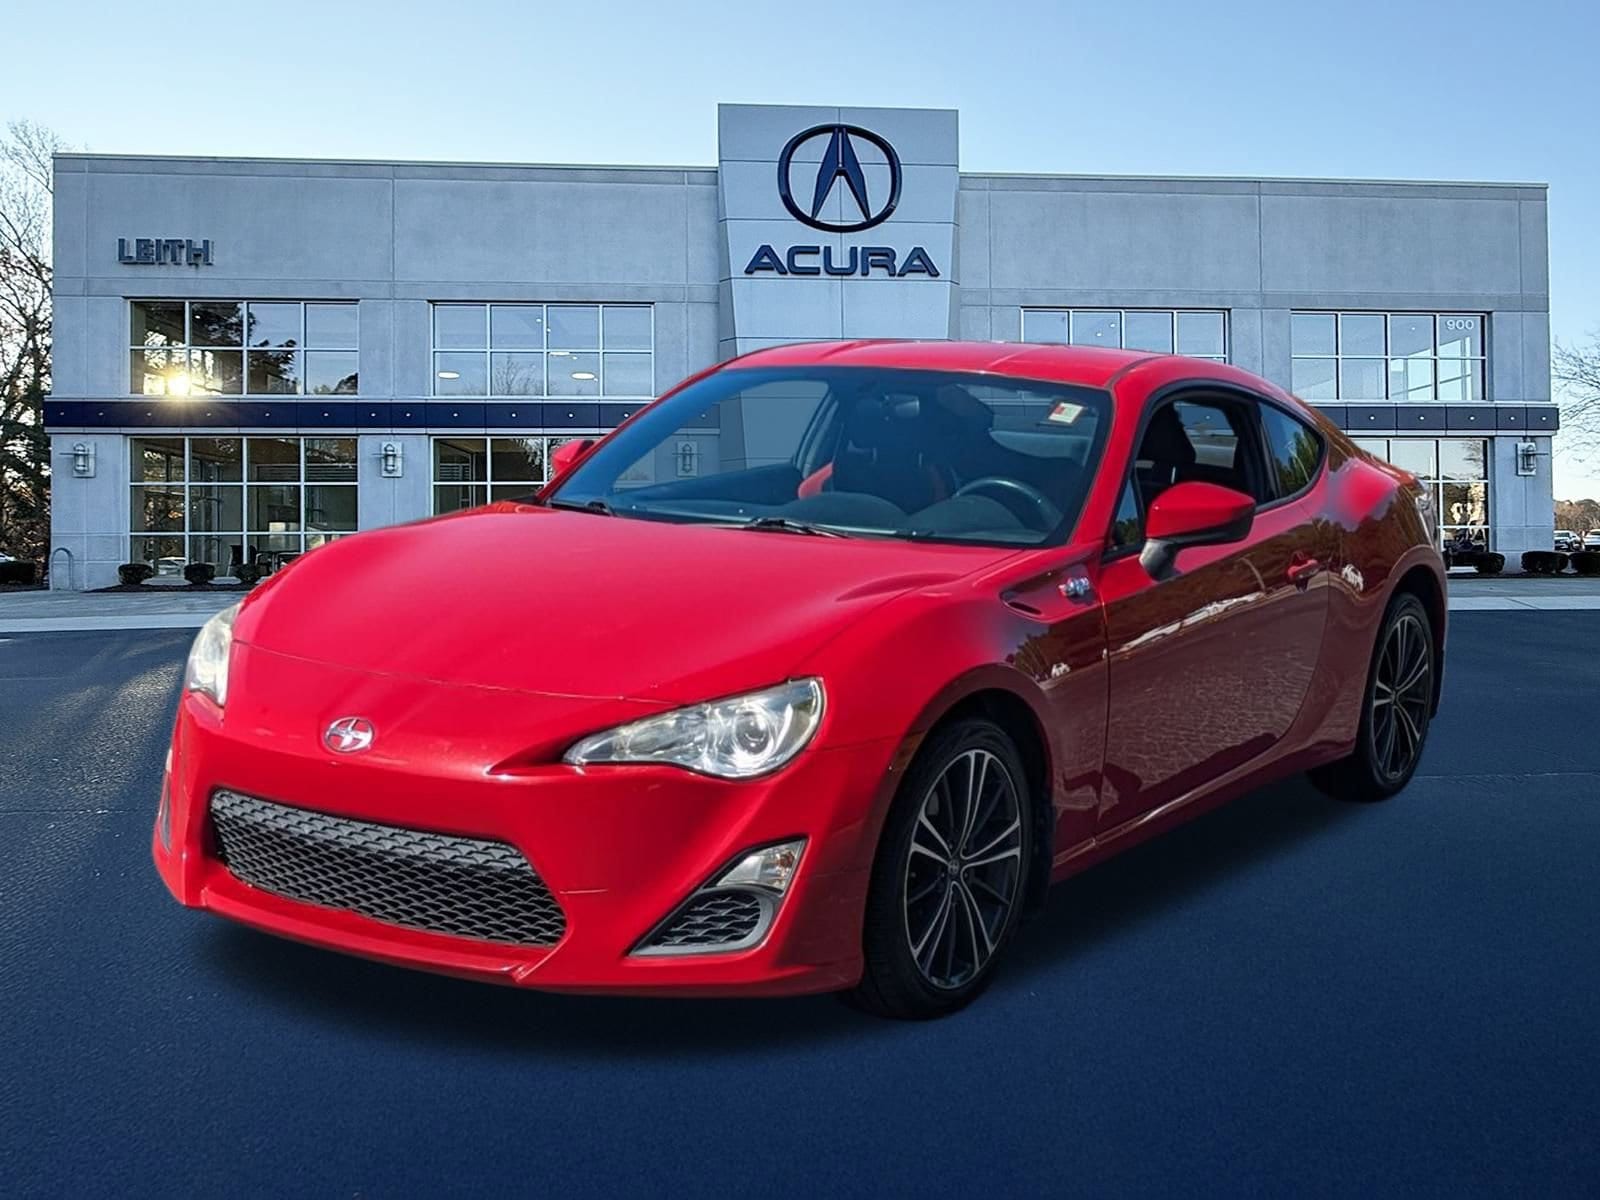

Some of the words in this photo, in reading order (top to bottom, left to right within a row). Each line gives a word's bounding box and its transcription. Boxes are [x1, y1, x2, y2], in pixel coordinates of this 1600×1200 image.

[118, 238, 212, 265] LEITH
[744, 244, 940, 277] ACURA
[1446, 319, 1474, 330] 900
